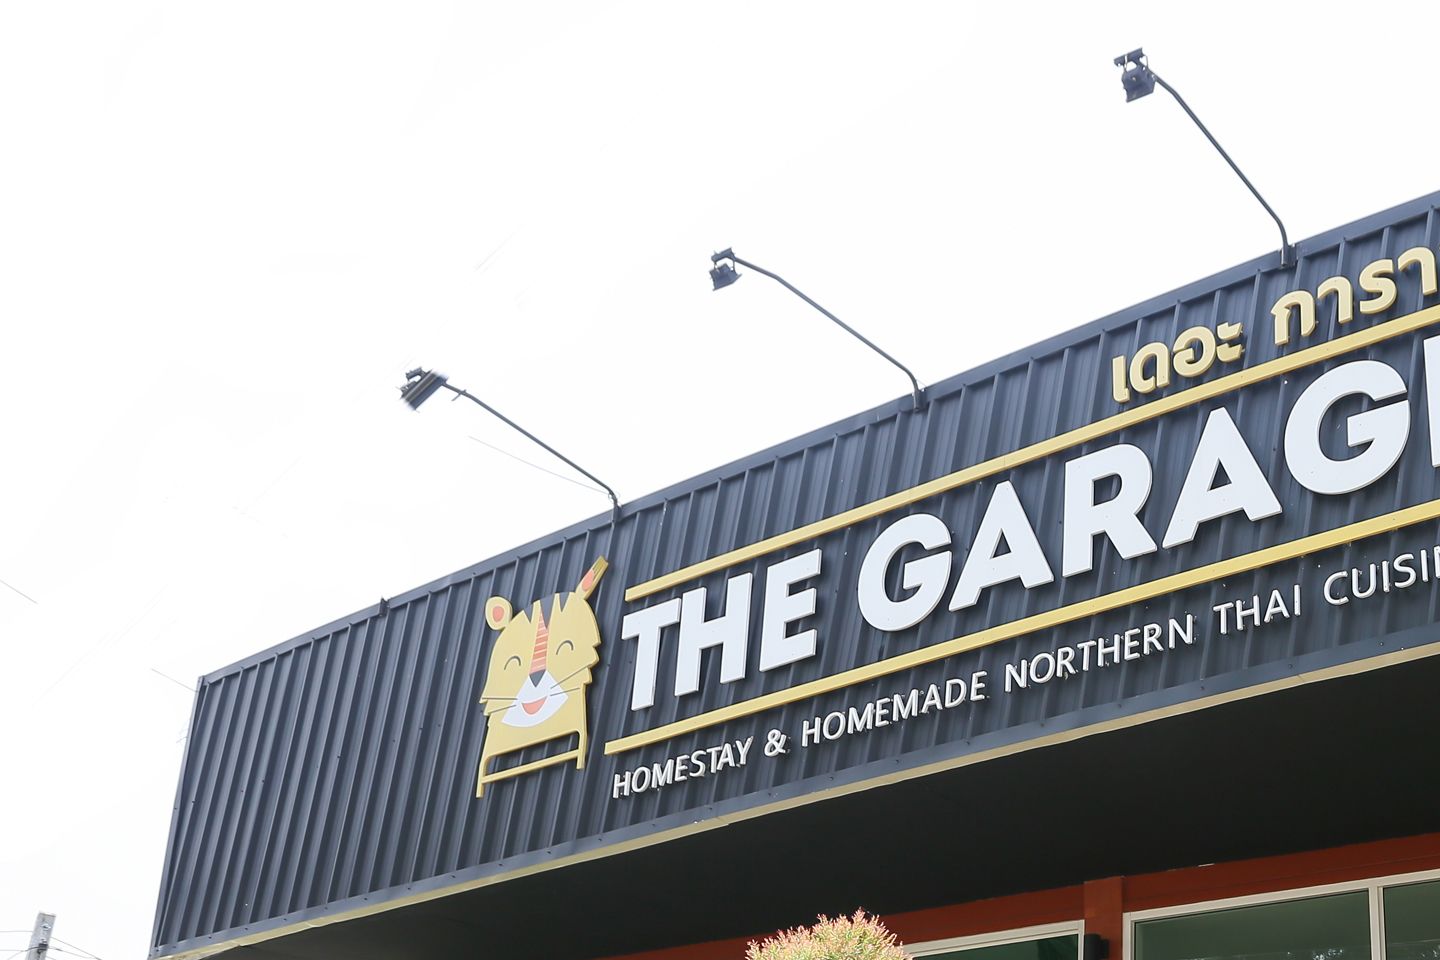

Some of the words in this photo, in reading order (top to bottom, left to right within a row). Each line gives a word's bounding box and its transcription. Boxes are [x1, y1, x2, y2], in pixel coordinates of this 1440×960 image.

[1112, 322, 1245, 404] เดอะ
[612, 736, 754, 799] HOMESTAY
[763, 728, 788, 757] &
[800, 671, 988, 748] HOMEMADE
[1004, 614, 1195, 693] NORTHERN
[1214, 584, 1303, 635] THAI
[621, 548, 823, 712] THE
